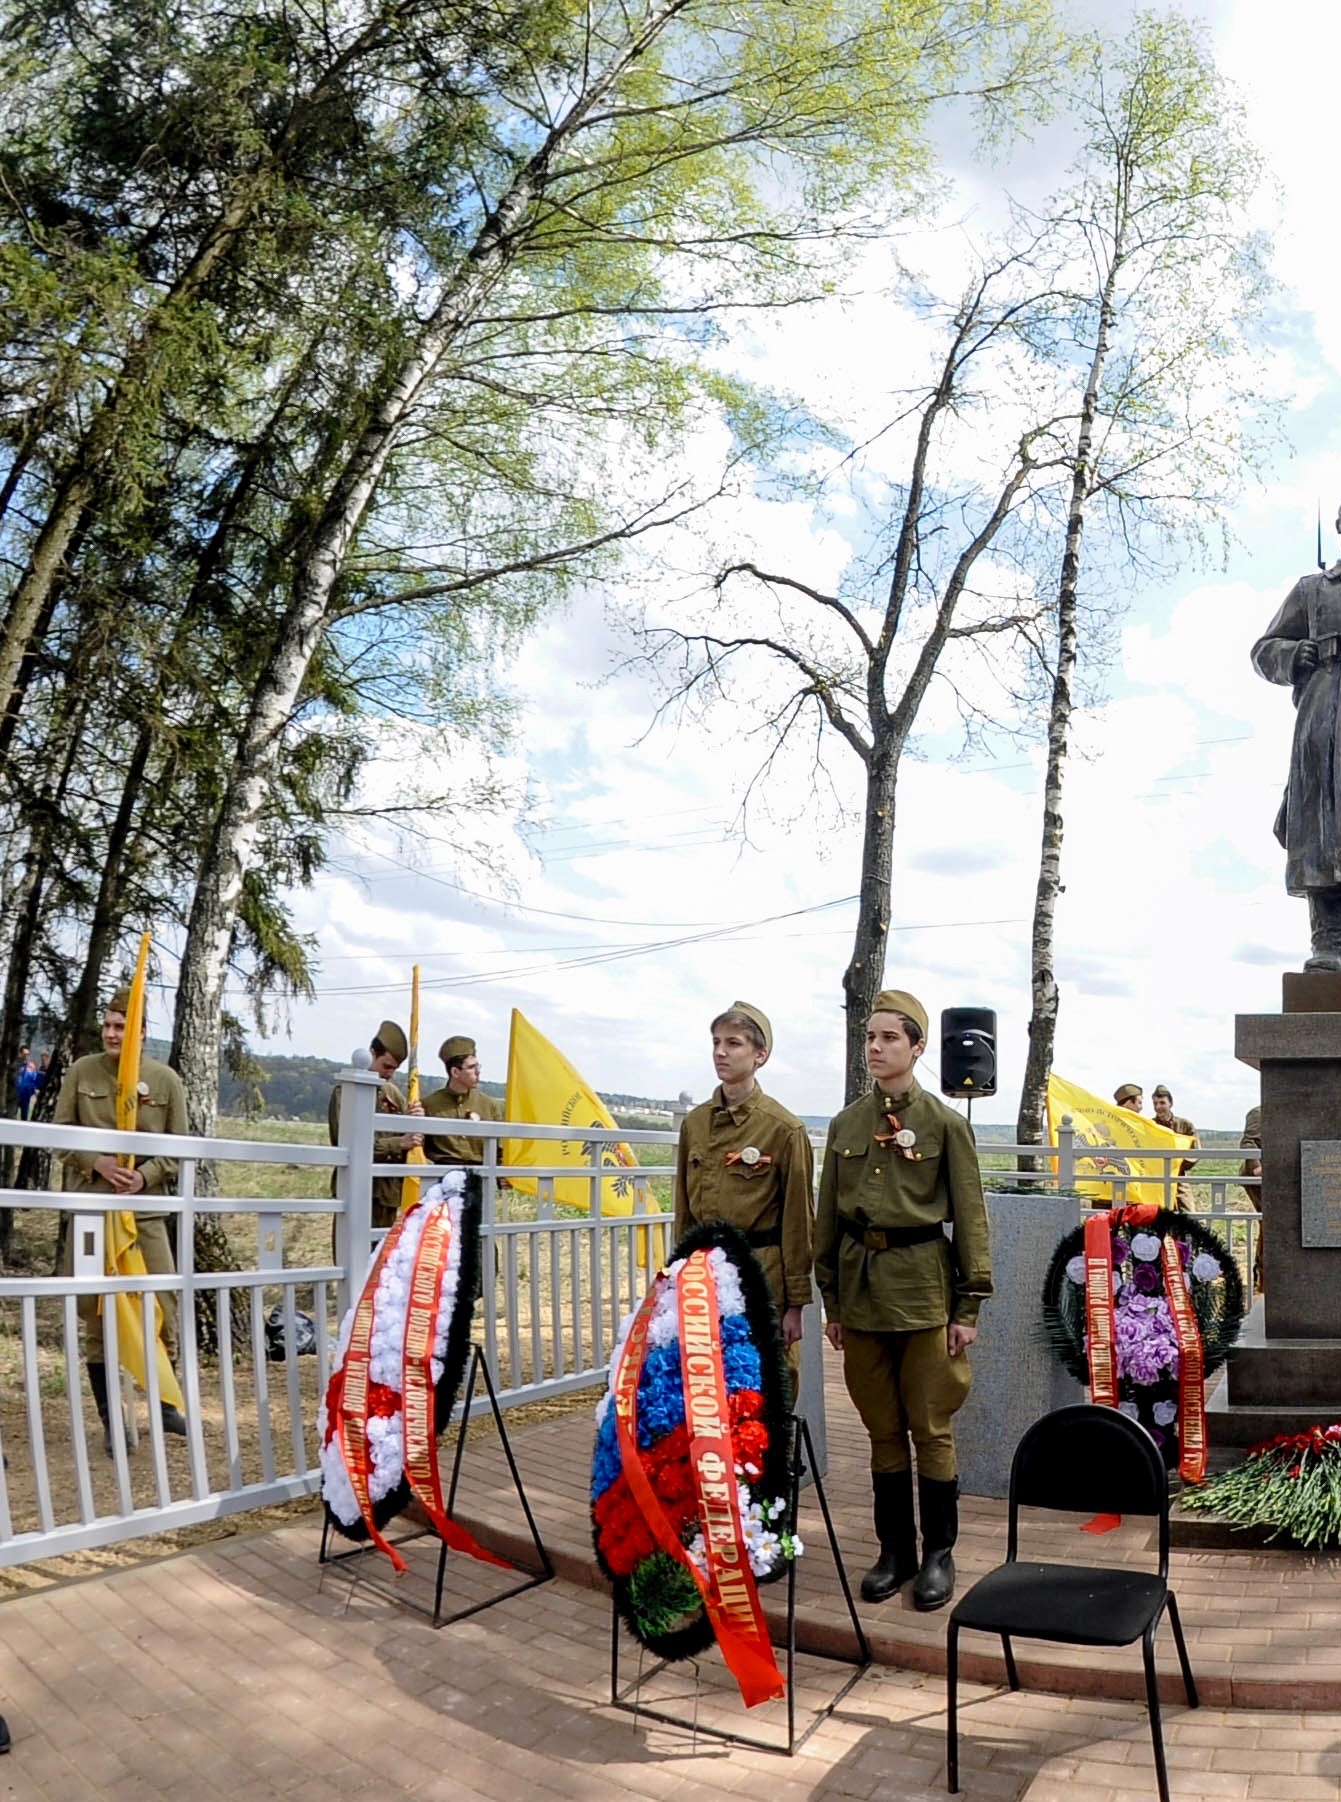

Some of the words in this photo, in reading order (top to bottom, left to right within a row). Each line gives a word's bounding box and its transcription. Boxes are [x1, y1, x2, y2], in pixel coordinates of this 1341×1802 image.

[1088, 1269, 1109, 1305] РАЙОНА
[1175, 1313, 1202, 1381] ГОРОДСКОГО
[1184, 1384, 1204, 1450] ПОСЕЛЕНИЯ
